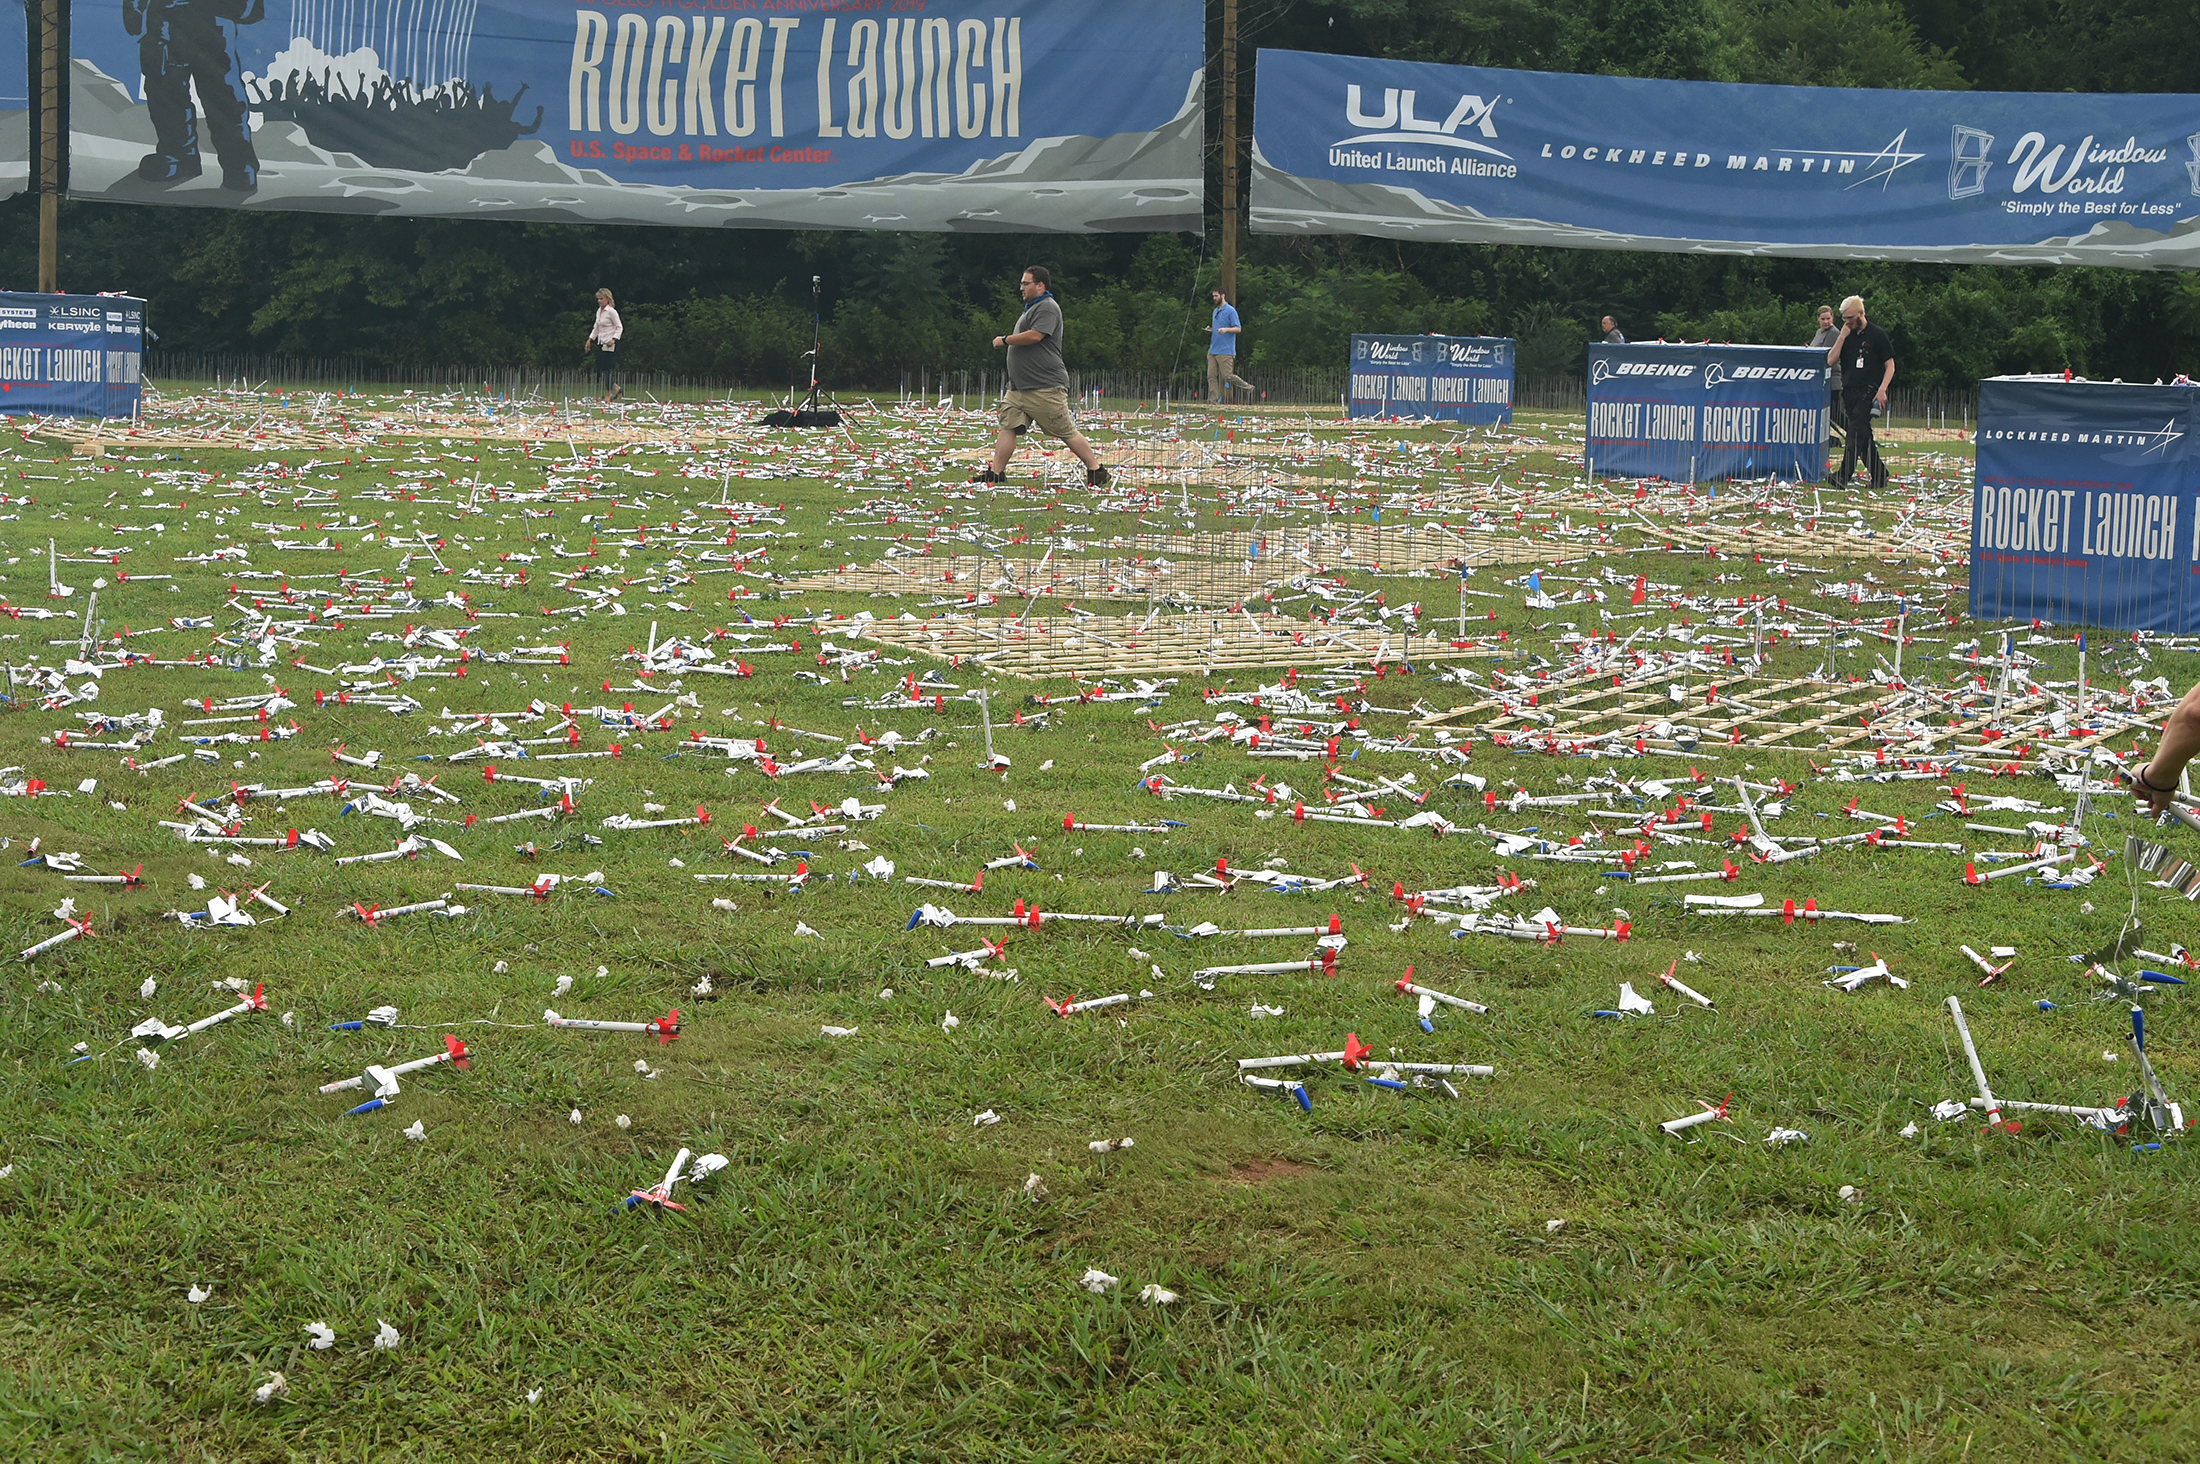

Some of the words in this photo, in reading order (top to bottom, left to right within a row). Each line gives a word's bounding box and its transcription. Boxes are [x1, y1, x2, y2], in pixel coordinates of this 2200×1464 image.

[678, 0, 757, 11] GOLDEN
[762, 0, 885, 12] ANNIVERSARY
[889, 0, 927, 12] 2019
[1345, 83, 1502, 138] ULA
[570, 139, 607, 158] U.S.
[612, 141, 673, 163] Space
[677, 143, 693, 162] &
[699, 144, 764, 163] Rocket
[769, 145, 832, 163] Center
[1540, 143, 1712, 169] LOCKHEED
[1725, 154, 1856, 174] MARTIN
[1328, 148, 1382, 169] United
[1386, 152, 1447, 174] Launch
[1450, 157, 1518, 179] Alliance
[2007, 131, 2168, 194] Window
[2000, 201, 2054, 217] "Simply
[2058, 201, 2083, 214] the
[2084, 201, 2117, 215] Best
[2119, 202, 2139, 215] for
[2141, 202, 2182, 216] Less"
[61, 306, 101, 317] LSINC
[48, 321, 102, 334] KBRwyle
[0, 347, 41, 381] CKET
[1616, 363, 1695, 377] BOEING
[1731, 366, 1817, 380] BOEING
[1985, 429, 2071, 443] LOCKHEED
[2077, 433, 2147, 446] MARTIN
